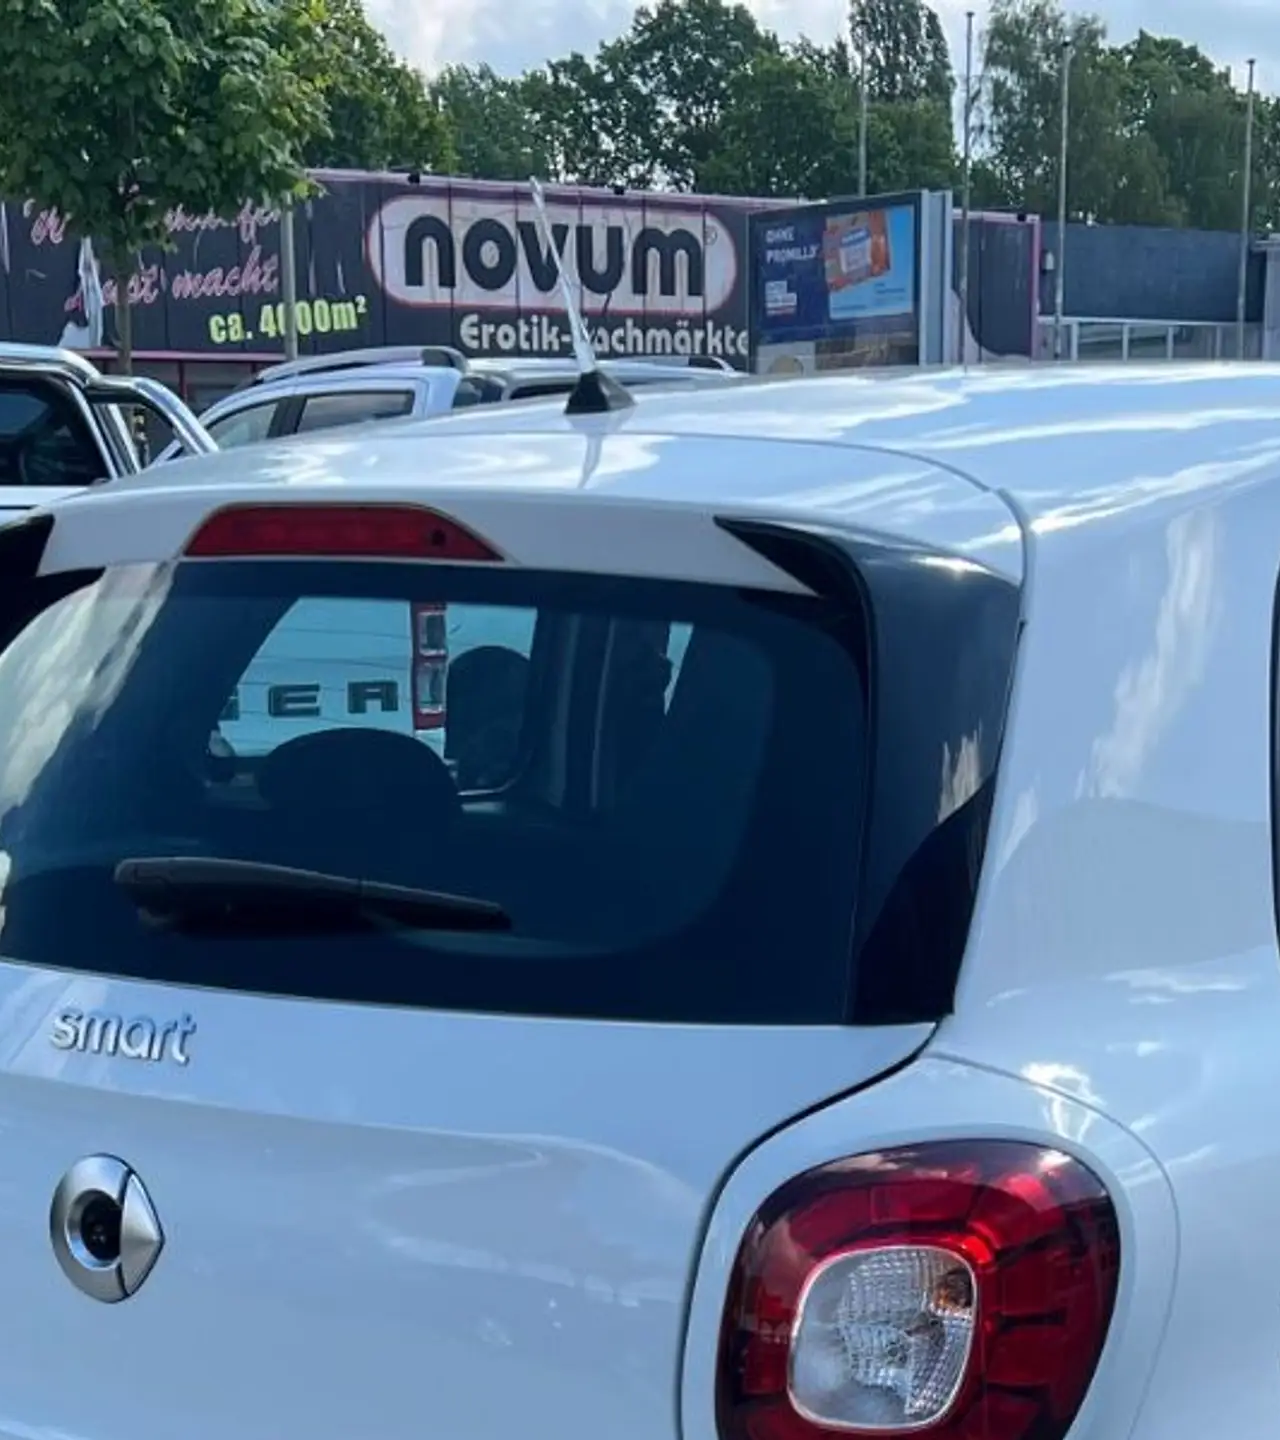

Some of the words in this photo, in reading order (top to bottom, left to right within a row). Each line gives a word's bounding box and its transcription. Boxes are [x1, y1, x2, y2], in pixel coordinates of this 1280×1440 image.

[404, 214, 705, 298] novum
[209, 313, 253, 344] ca.
[460, 313, 749, 356] Erotik-achmärkte
[47, 1005, 198, 1068] smart
